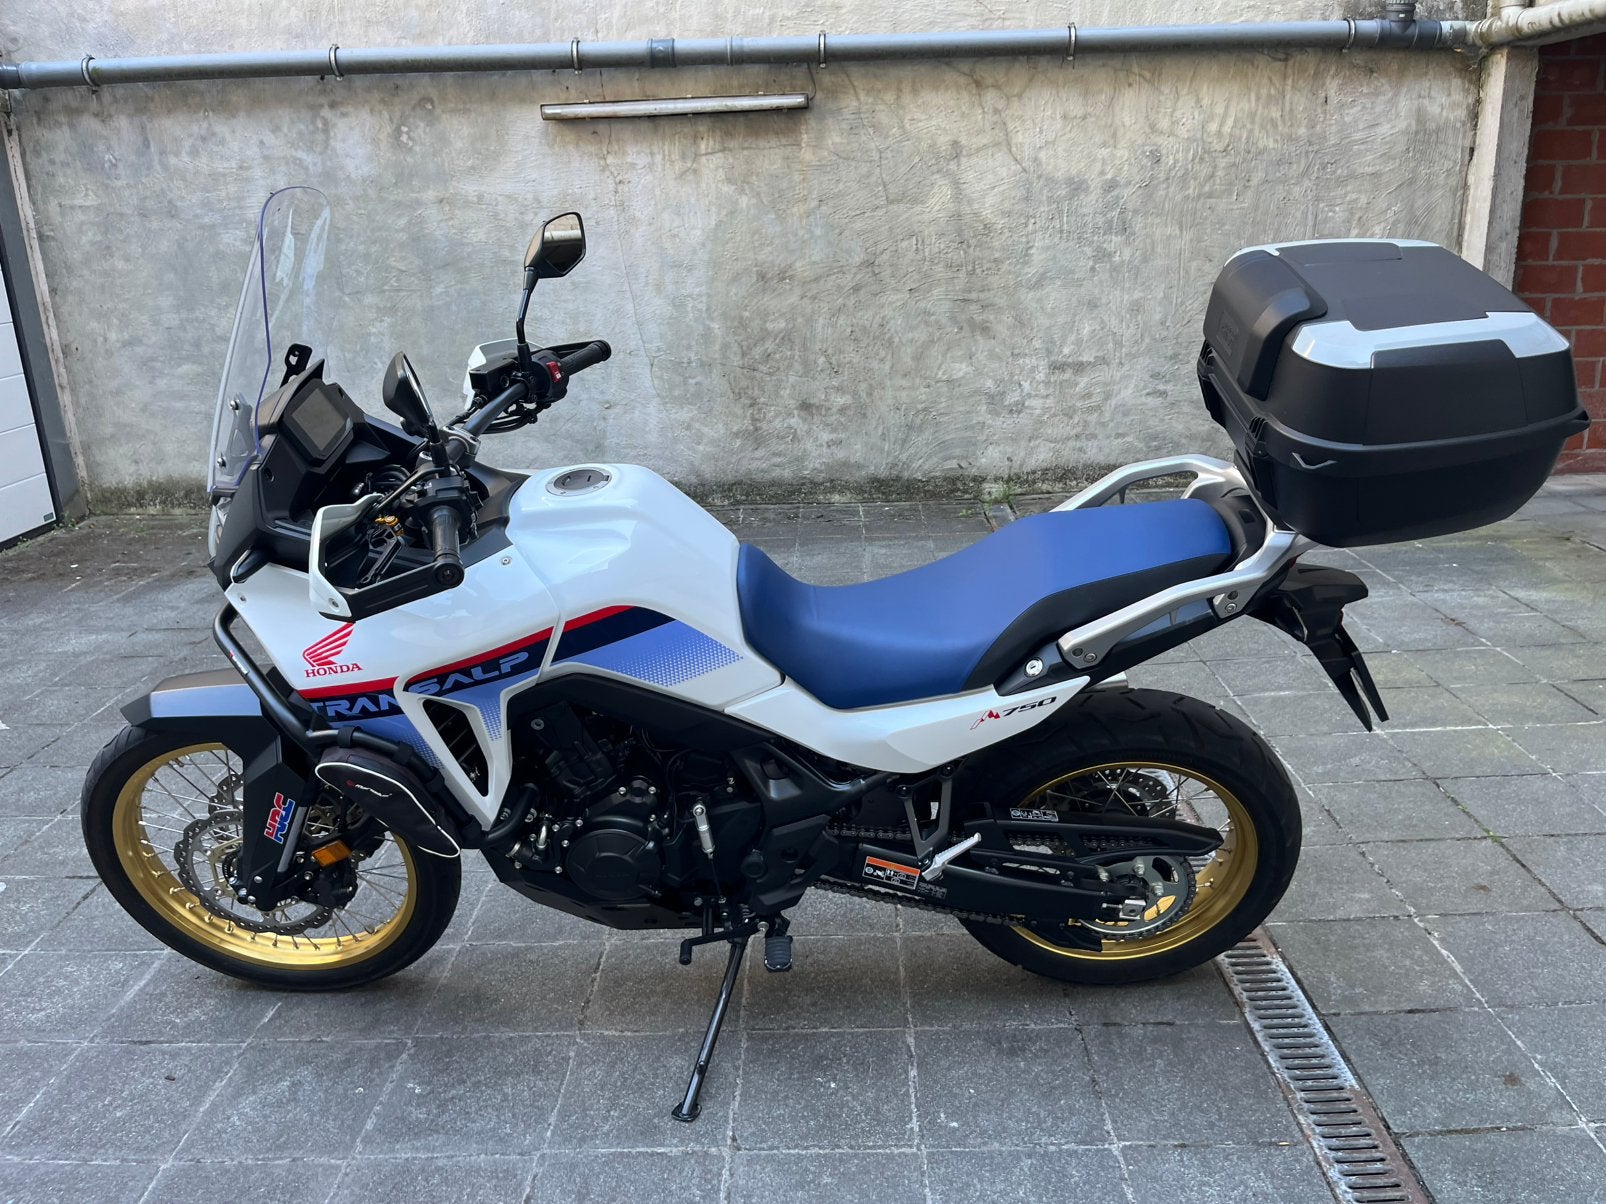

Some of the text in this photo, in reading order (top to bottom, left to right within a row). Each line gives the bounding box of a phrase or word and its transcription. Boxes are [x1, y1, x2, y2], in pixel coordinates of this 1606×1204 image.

[304, 662, 363, 678] HONDA
[1002, 696, 1057, 717] 750
[264, 792, 295, 844] HRC
